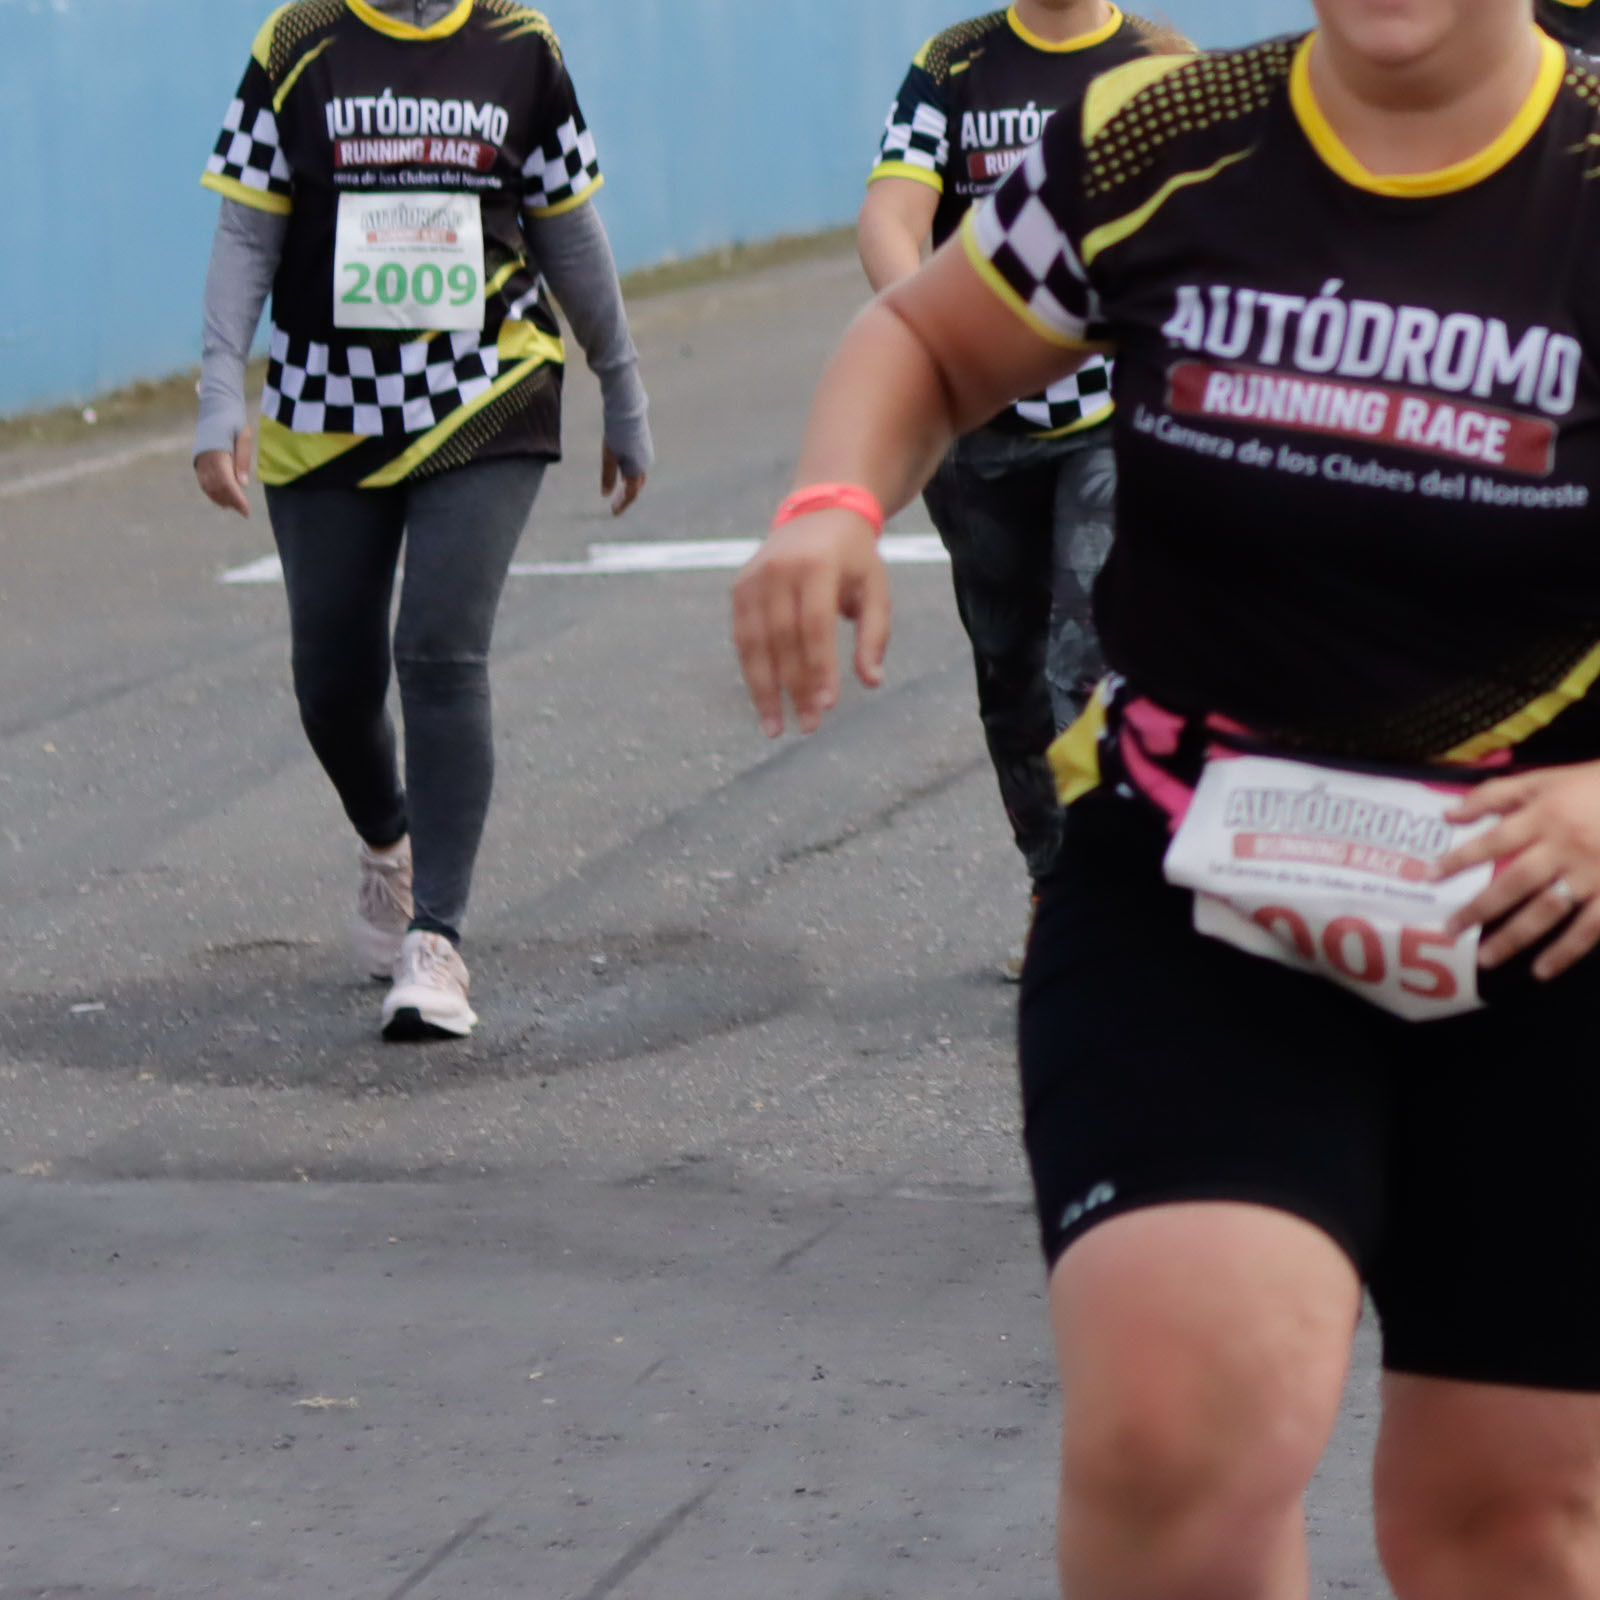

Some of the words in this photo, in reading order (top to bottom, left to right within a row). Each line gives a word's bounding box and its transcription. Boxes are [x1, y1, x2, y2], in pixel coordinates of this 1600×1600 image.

[340, 138, 424, 166] RUNNING
[430, 140, 481, 168] RACE
[341, 262, 477, 307] 2009
[1160, 278, 1582, 416] AUTÓDROMO
[1133, 403, 1156, 434] La
[1154, 415, 1234, 459] Carrera
[1237, 438, 1274, 468] de
[1277, 444, 1318, 477] los
[1322, 453, 1415, 493] Clubes
[1418, 469, 1465, 500] del
[1469, 475, 1590, 508] Noroeste
[1203, 371, 1389, 435] RUNNING
[1394, 396, 1512, 464] RACE
